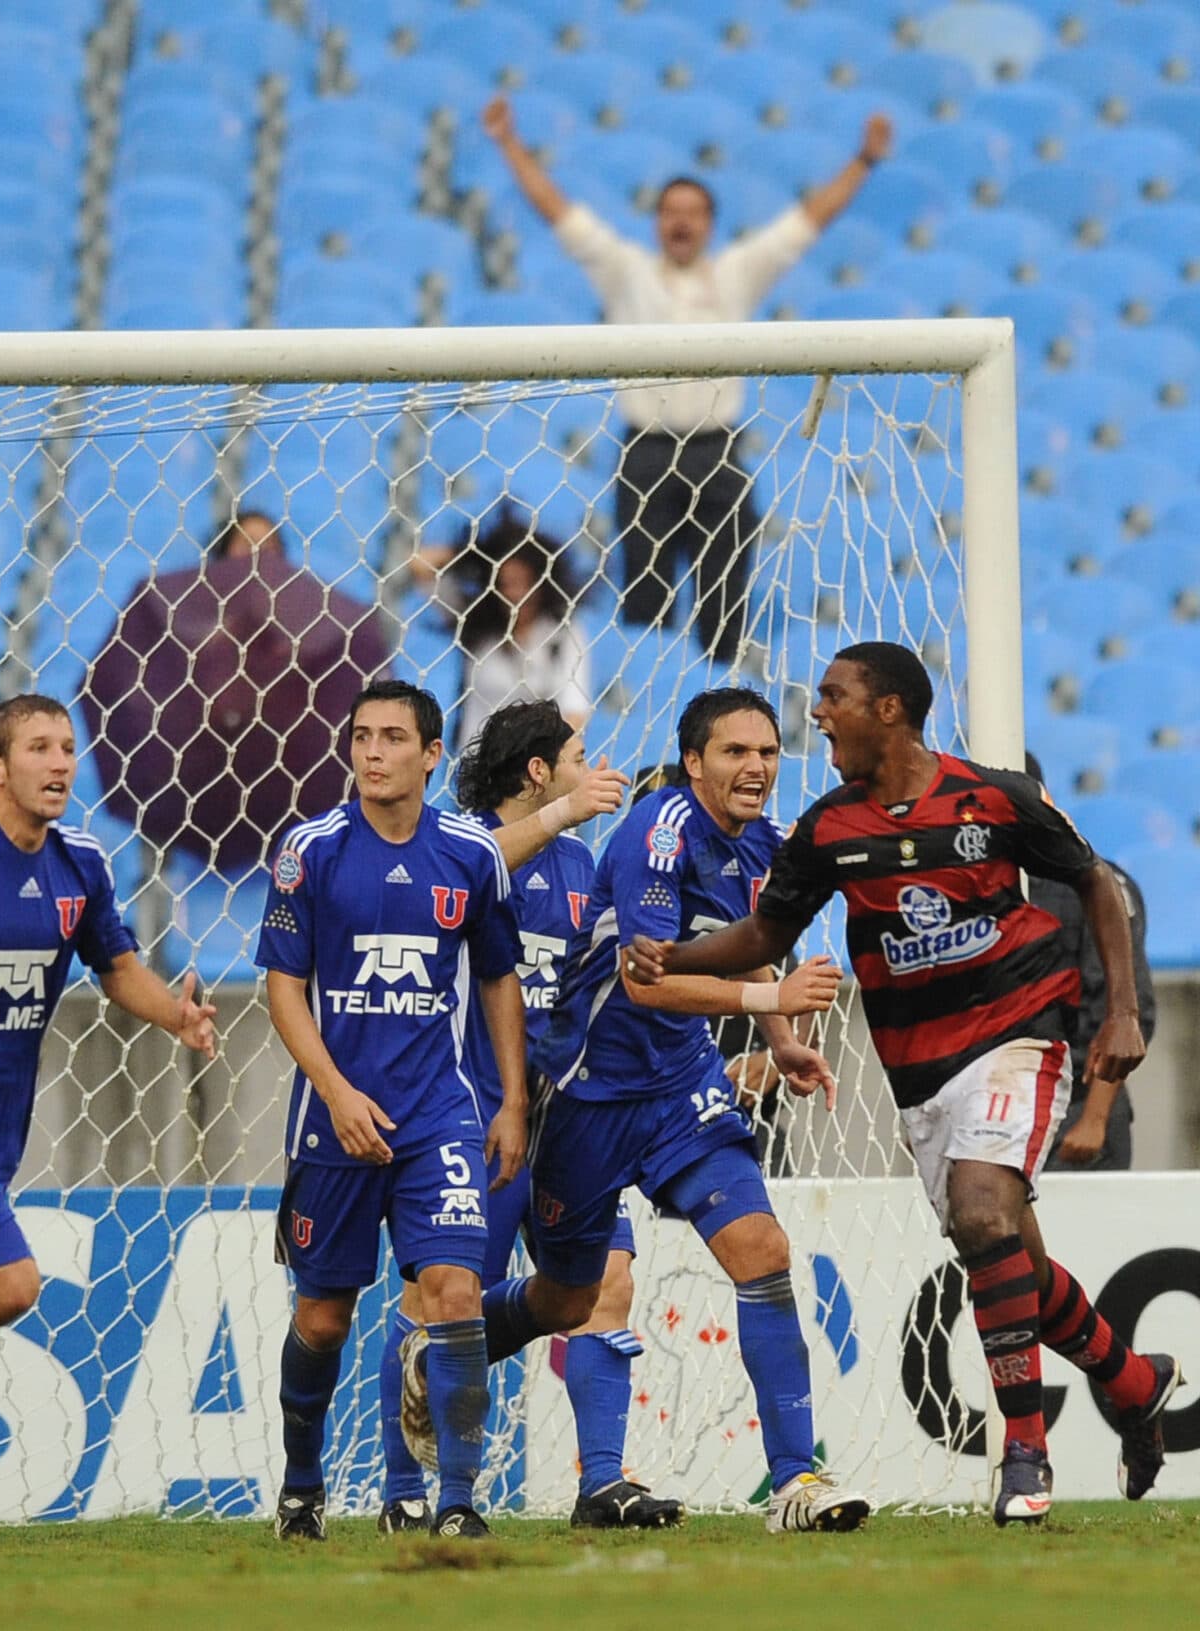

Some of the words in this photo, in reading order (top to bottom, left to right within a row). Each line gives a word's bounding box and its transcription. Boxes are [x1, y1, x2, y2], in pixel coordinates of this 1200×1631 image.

[56, 896, 87, 940] U
[431, 885, 469, 930] U
[883, 915, 992, 966] batavo
[986, 1093, 1011, 1121] 11
[439, 1141, 471, 1187] 5
